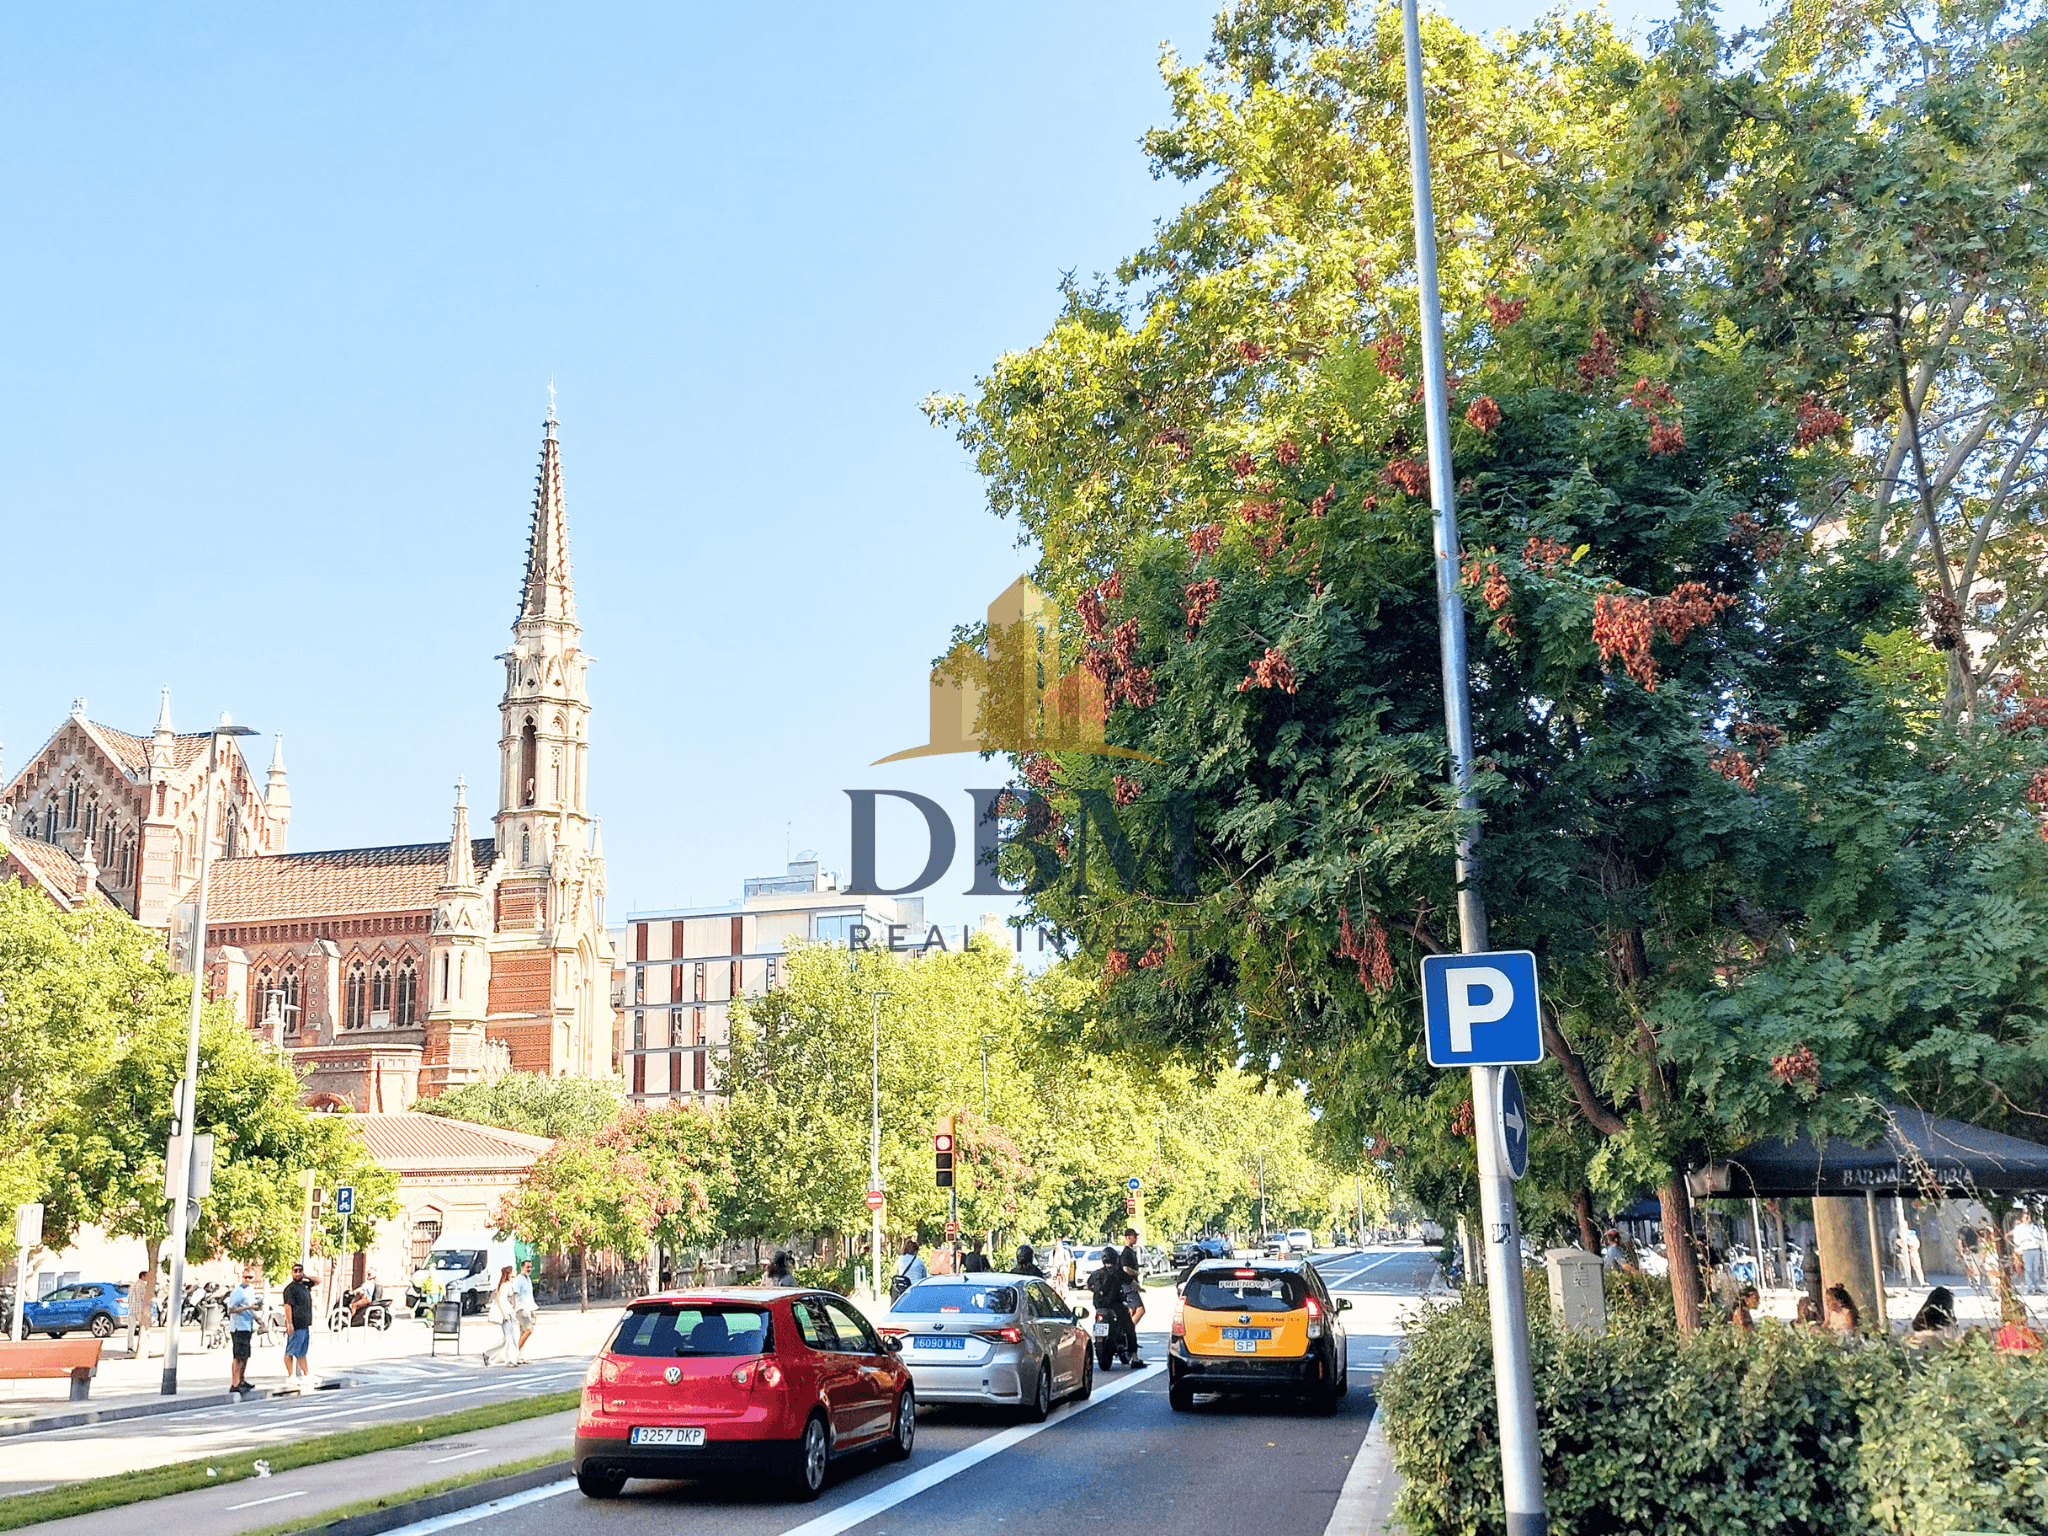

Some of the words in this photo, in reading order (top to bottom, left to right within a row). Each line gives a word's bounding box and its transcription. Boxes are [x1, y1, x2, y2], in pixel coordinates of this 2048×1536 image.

[1445, 966, 1514, 1053] P
[341, 1190, 349, 1202] P
[919, 1338, 944, 1348] 6090
[1236, 1341, 1254, 1351] SP
[640, 1429, 674, 1442] 3257
[676, 1429, 702, 1443] DKP
